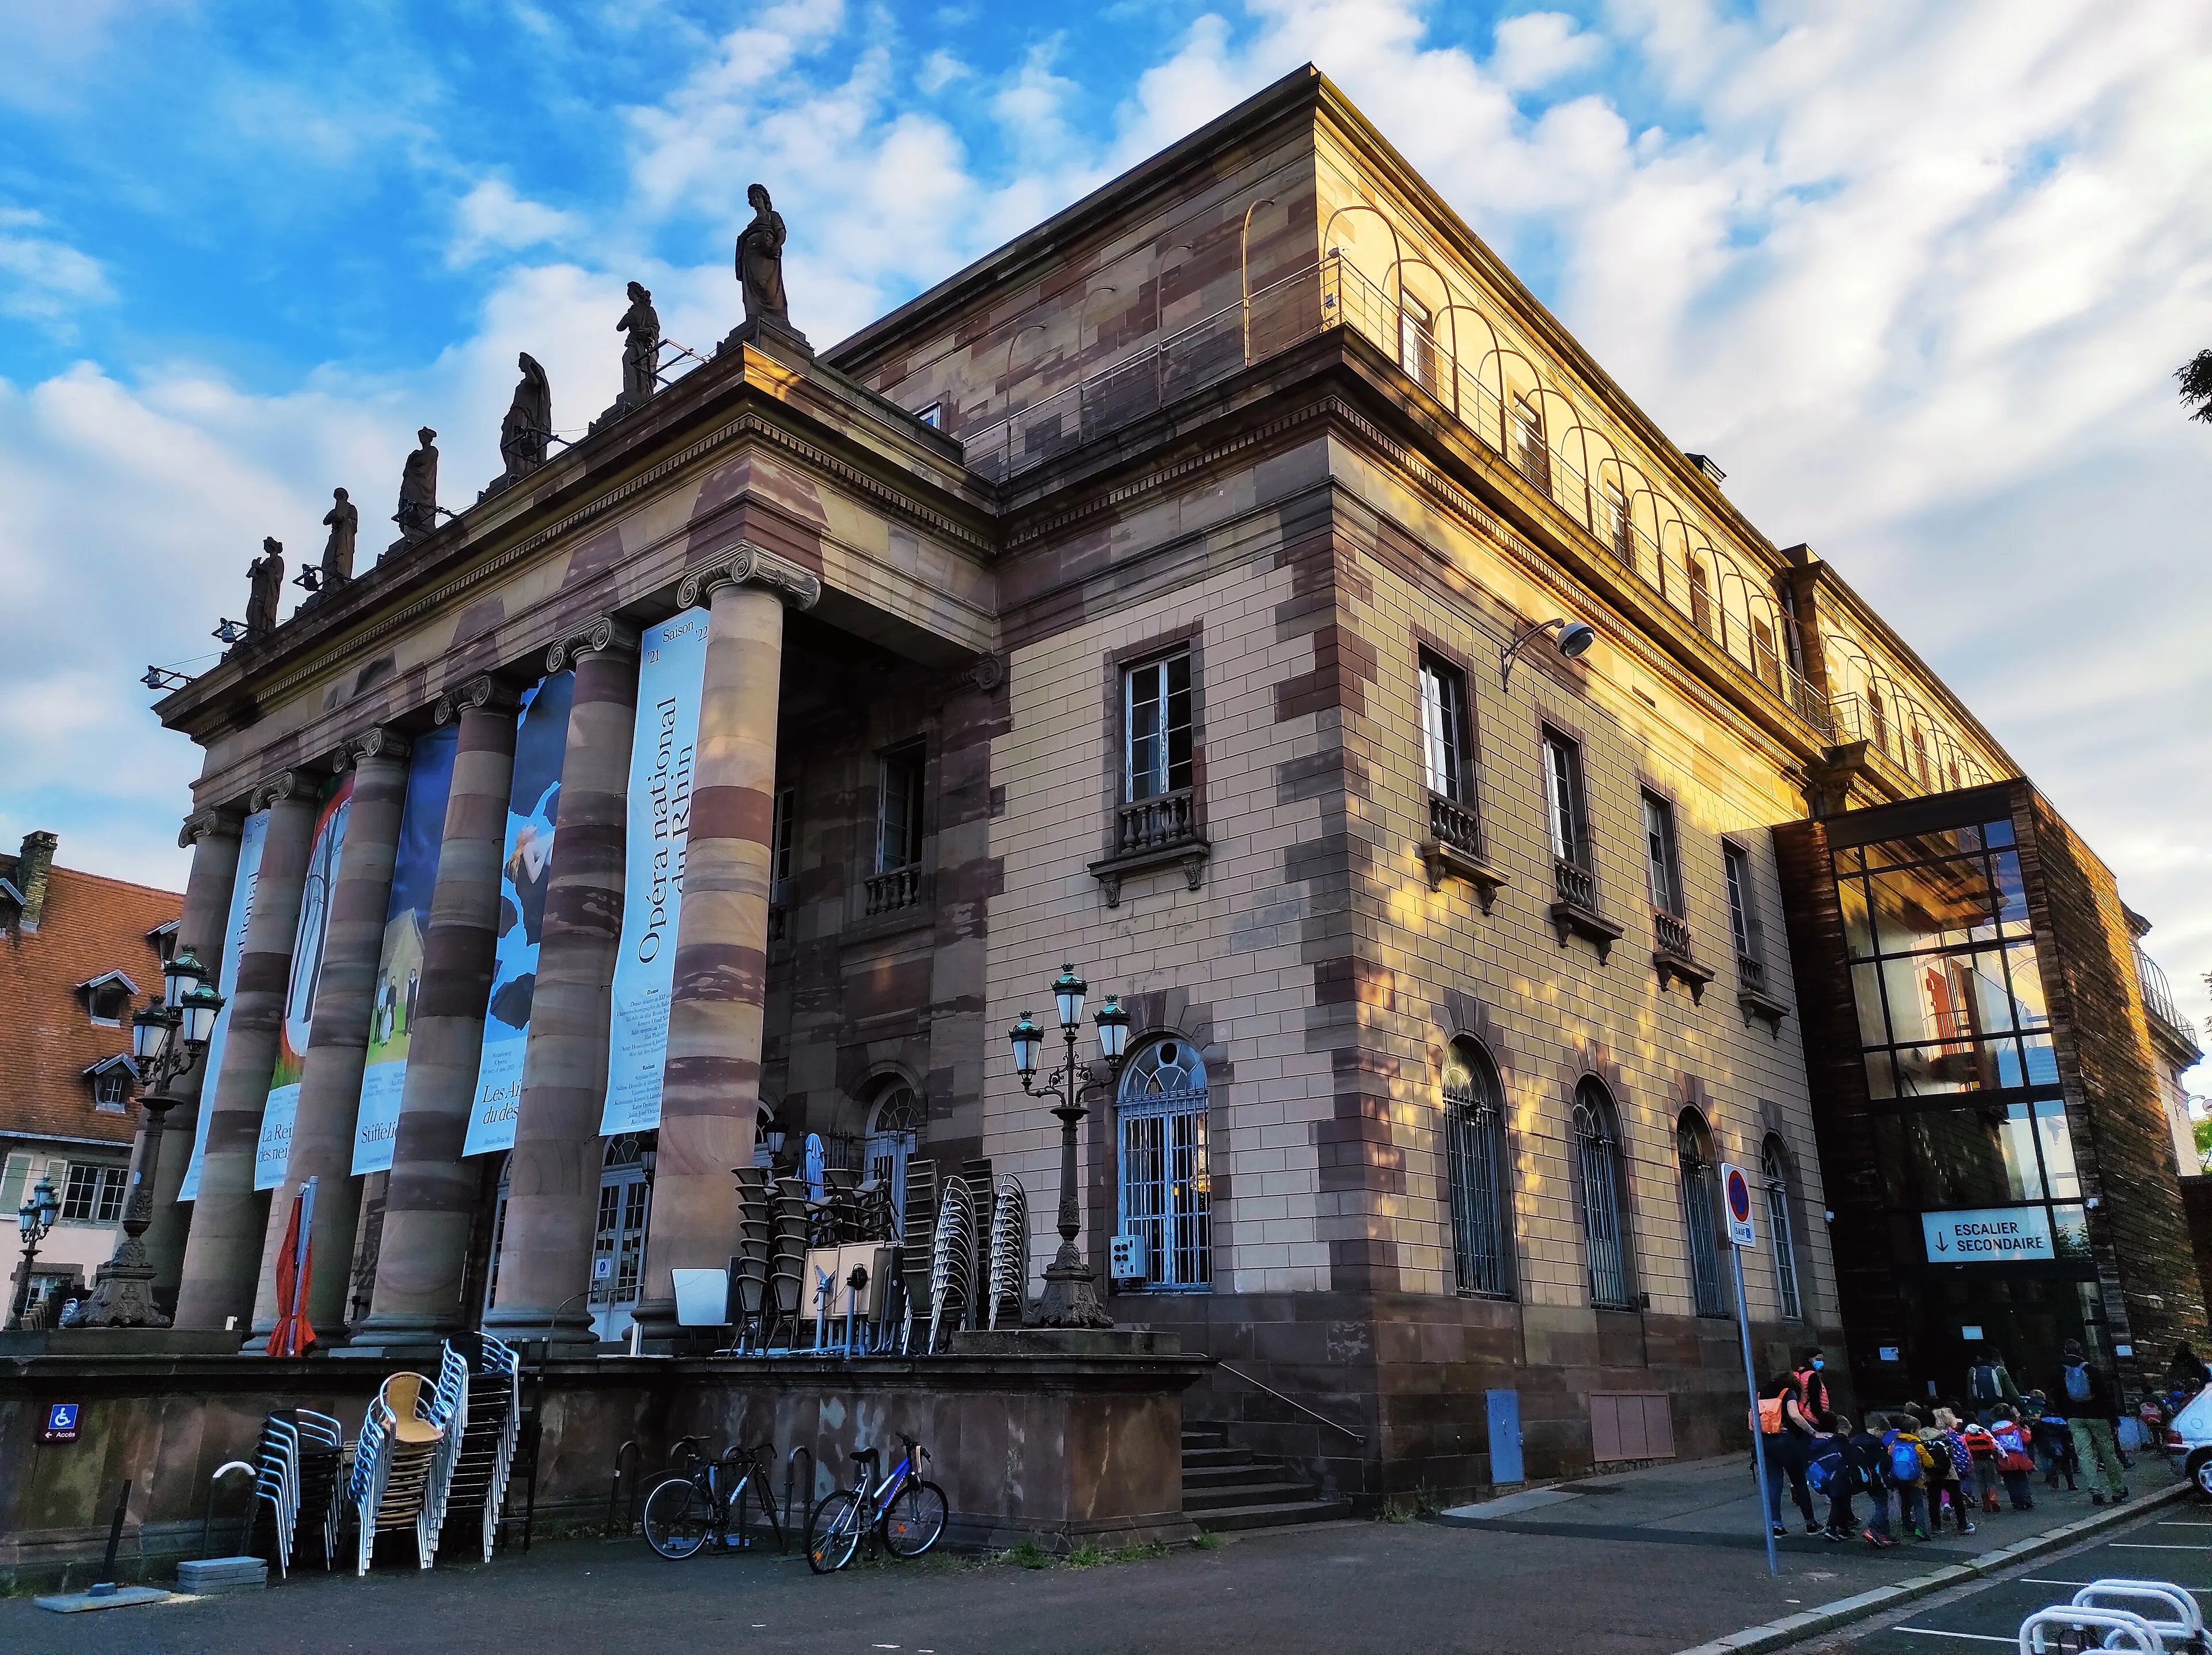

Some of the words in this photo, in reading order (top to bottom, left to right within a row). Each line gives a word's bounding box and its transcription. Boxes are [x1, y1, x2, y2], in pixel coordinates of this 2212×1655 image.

[663, 620, 694, 642] Saison
[647, 649, 660, 664] '21
[695, 626, 708, 642] '22
[647, 695, 677, 840] national
[671, 743, 693, 840] Rhin
[639, 847, 668, 964] Opéra
[482, 1085, 505, 1103] Les
[505, 1078, 521, 1099] Ai
[483, 1105, 498, 1124] du
[262, 1127, 272, 1142] La
[259, 1146, 271, 1162] des
[272, 1142, 289, 1160] nei
[1735, 1227, 1745, 1236] SAUF
[1955, 1222, 2019, 1236] ESCALIER
[1958, 1236, 2044, 1252] SECONDAIRE
